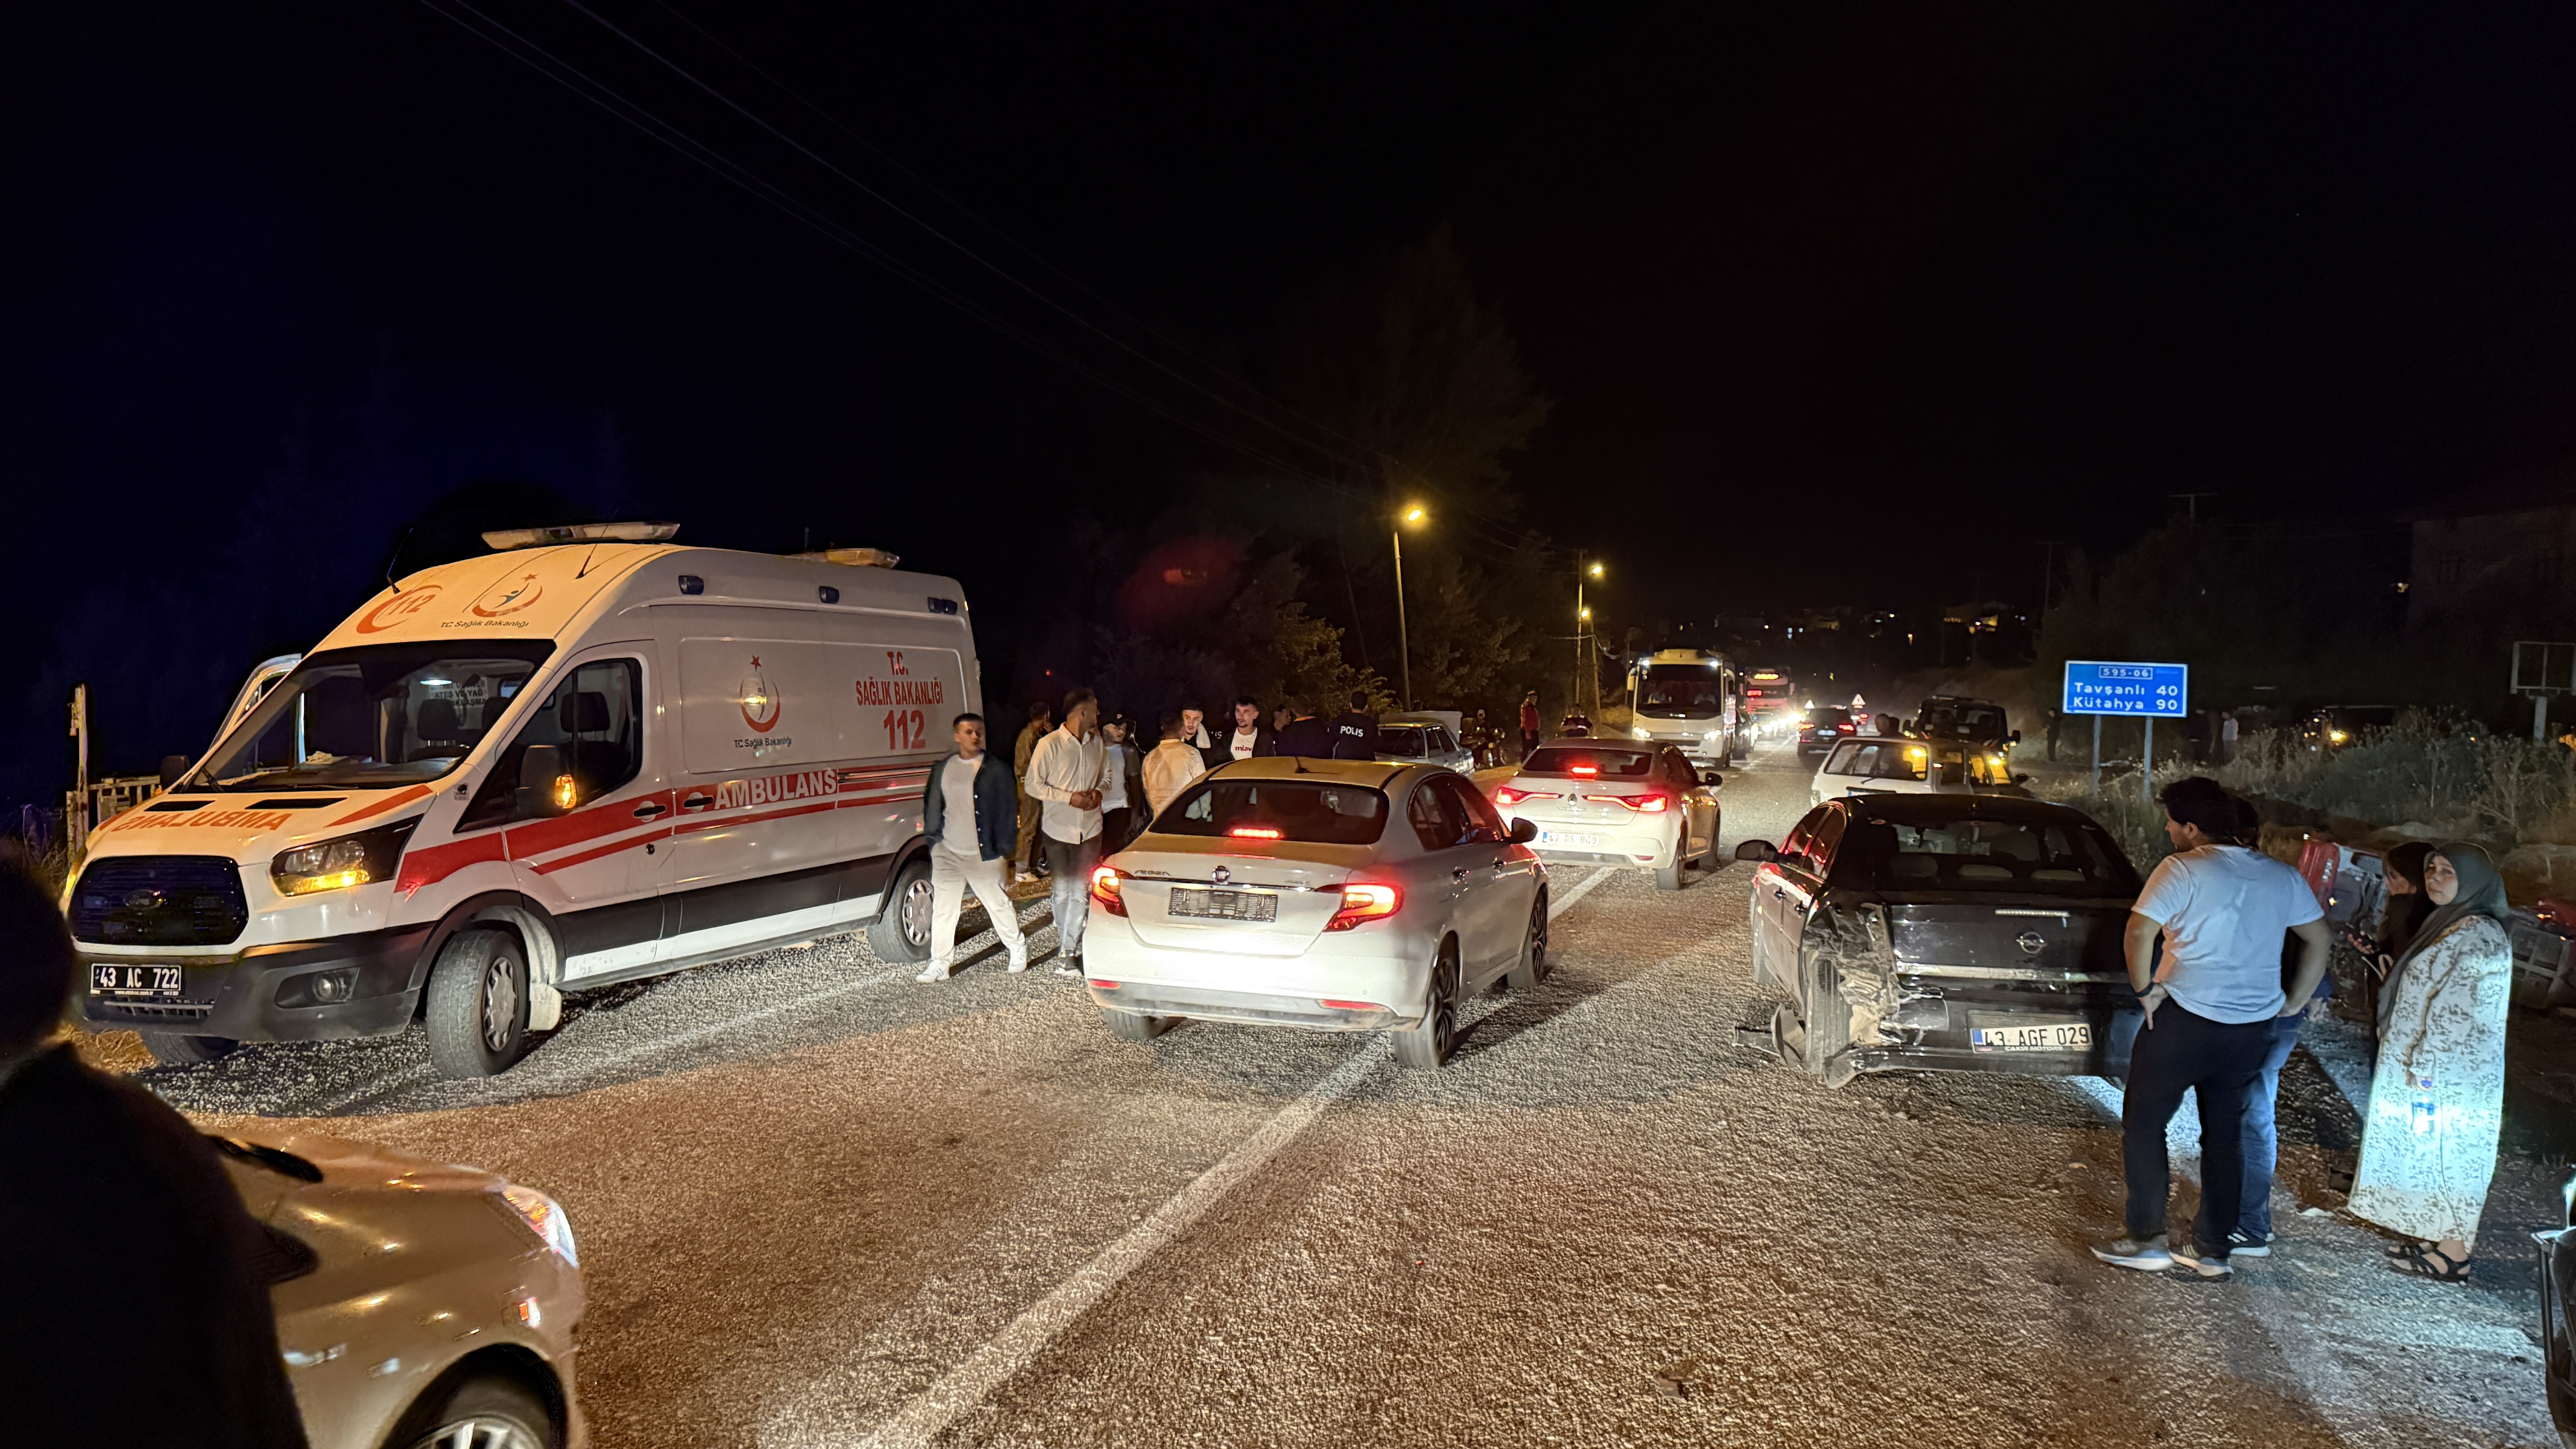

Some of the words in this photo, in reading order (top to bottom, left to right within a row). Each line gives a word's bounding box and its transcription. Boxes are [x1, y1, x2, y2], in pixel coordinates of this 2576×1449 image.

[387, 595, 436, 616] 112
[454, 620, 483, 628] Sağlık
[484, 620, 529, 628] Bakanlığı
[887, 651, 909, 675] T.C.
[2103, 668, 2148, 677] 595-06
[856, 676, 892, 706] SAĞLIK
[894, 677, 943, 705] BAKANLIĞI
[2075, 682, 2145, 695] Tavşanlı
[2156, 685, 2178, 696] 40
[2074, 696, 2144, 711] Kütahya
[2156, 699, 2177, 710] 90
[883, 709, 925, 750] 112
[714, 769, 837, 810] AMBULANS
[100, 967, 116, 988] 43
[126, 968, 142, 988] AC
[153, 968, 179, 989] 722
[1985, 1031, 2005, 1046] 43
[2056, 1026, 2090, 1045] 029
